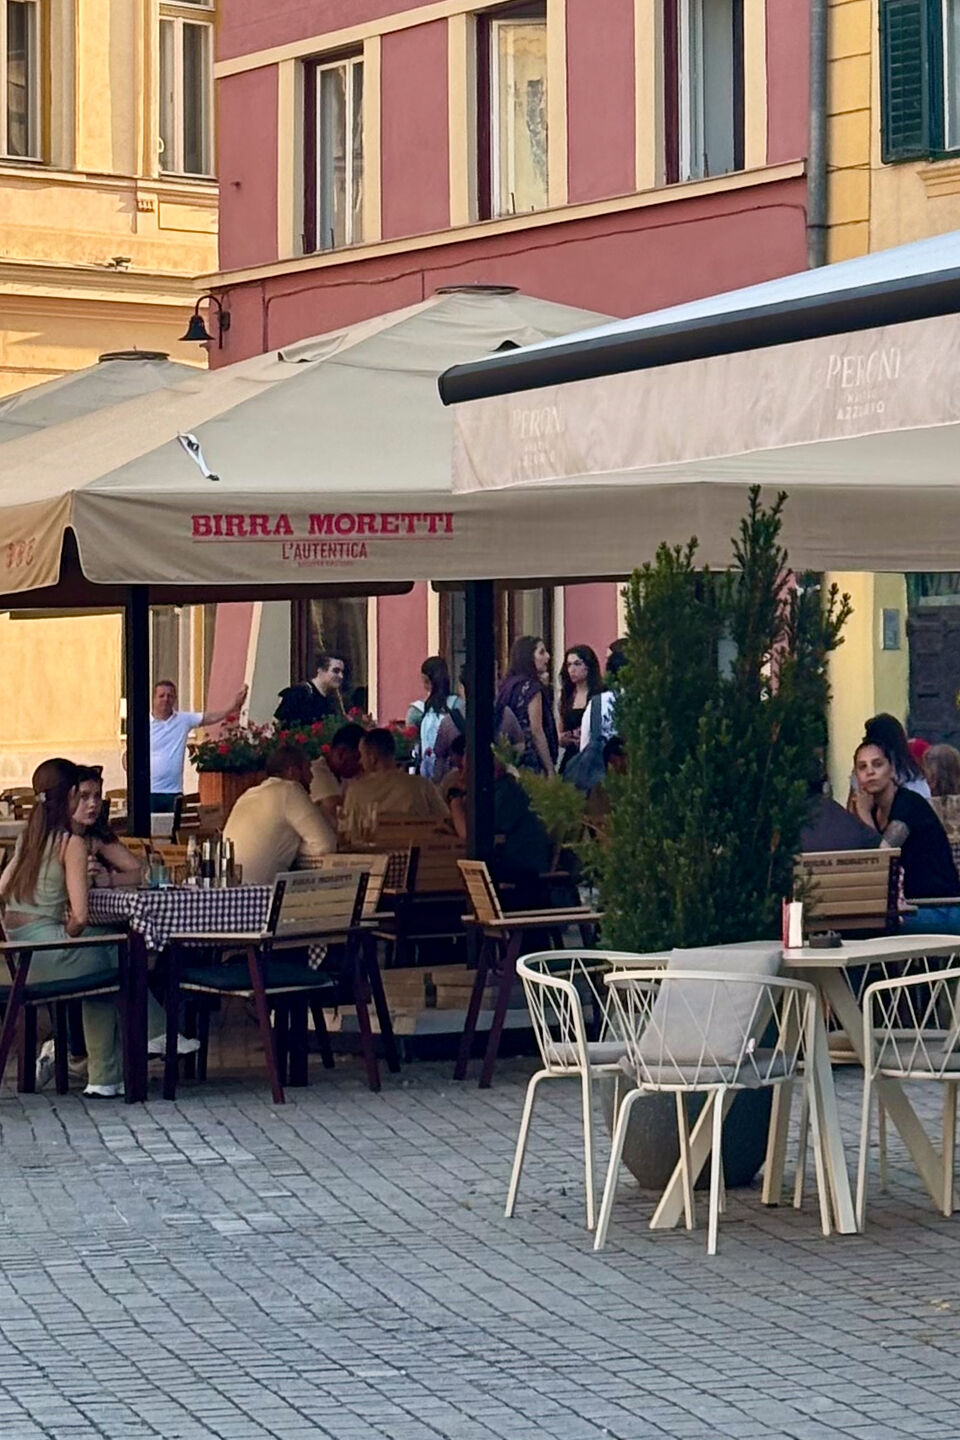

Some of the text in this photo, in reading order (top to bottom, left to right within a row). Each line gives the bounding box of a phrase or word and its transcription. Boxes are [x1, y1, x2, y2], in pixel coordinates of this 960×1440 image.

[191, 512, 455, 536] BIRRA MORETTI
[282, 542, 367, 560] L'AUTENTICA
